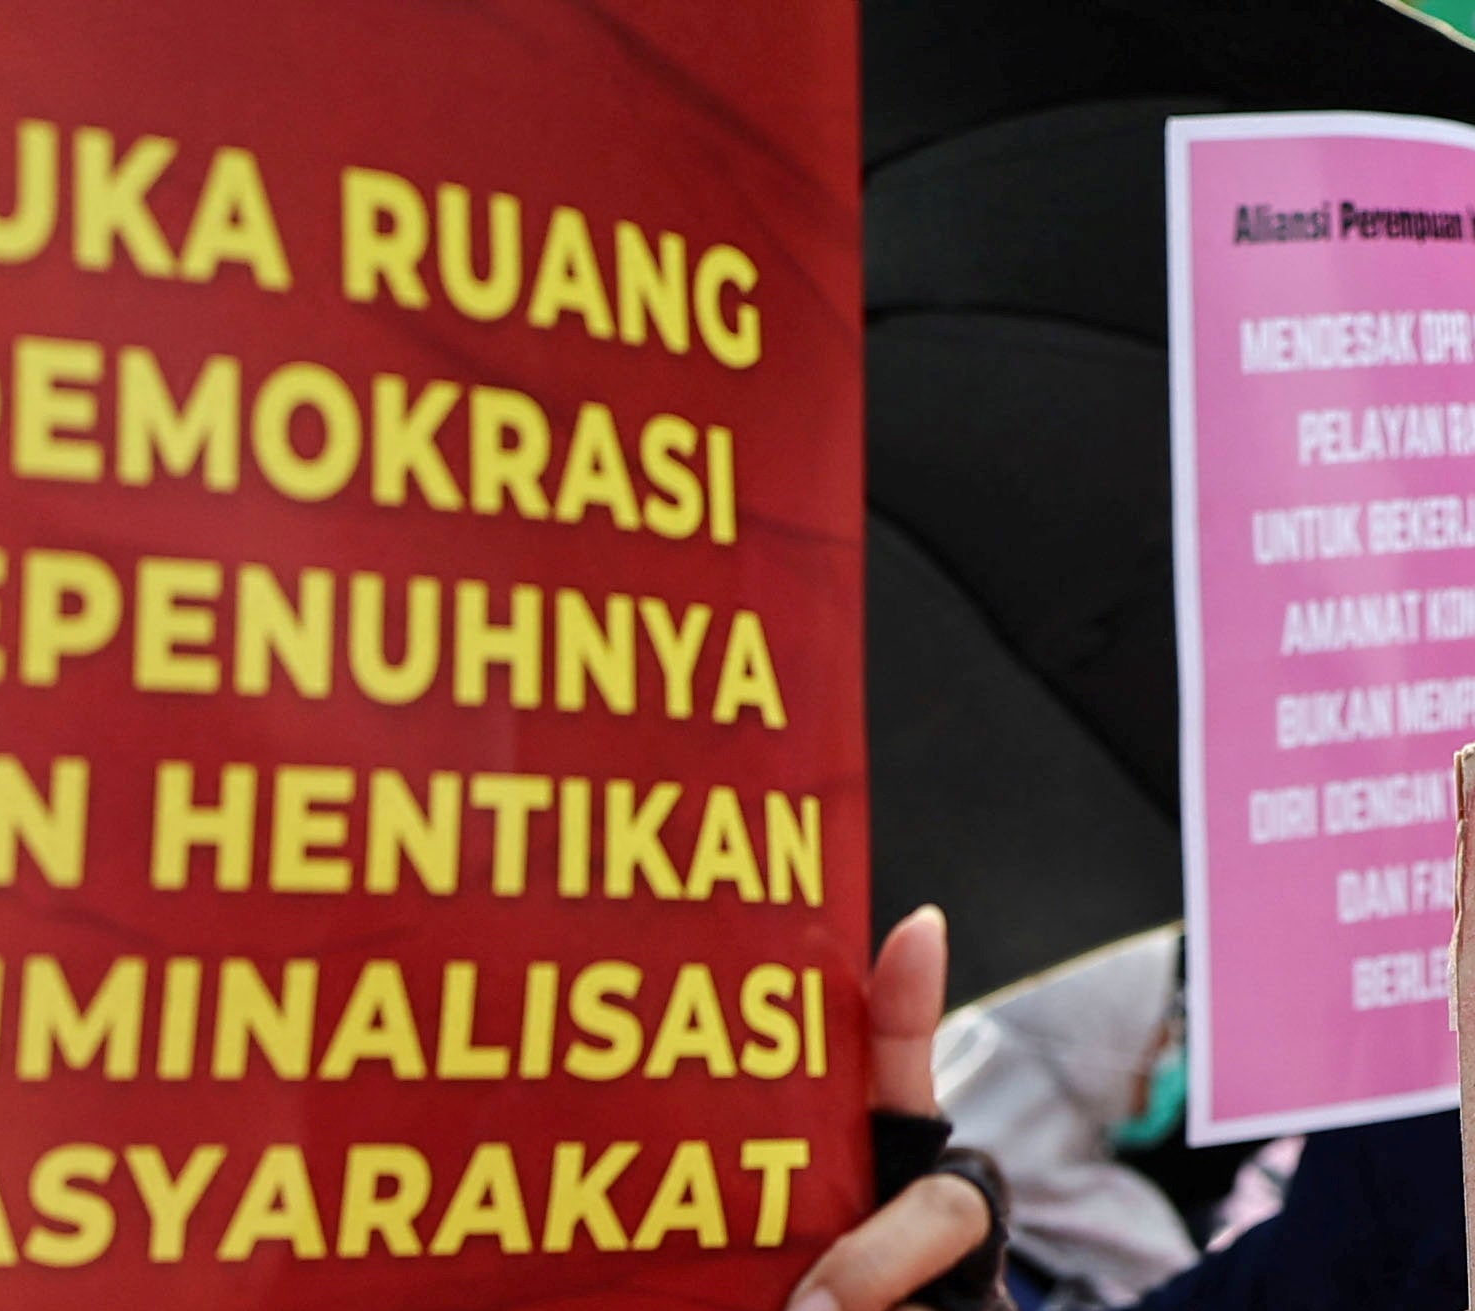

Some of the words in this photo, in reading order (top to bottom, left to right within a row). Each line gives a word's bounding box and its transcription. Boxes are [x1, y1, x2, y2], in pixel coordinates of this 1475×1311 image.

[1233, 202, 1332, 245] Aliansi
[1337, 201, 1464, 246] Perempuan
[342, 167, 761, 369] RUANG
[1239, 312, 1417, 376] MENDESAK
[1419, 309, 1472, 365] DPR
[1297, 403, 1446, 467] PELAYAN
[1252, 502, 1364, 565] UNTUK
[1279, 589, 1422, 657] AMANAT
[1275, 682, 1394, 750] BUKAN
[151, 761, 824, 907] HENTIKAN
[1249, 785, 1318, 846] DIRI
[1322, 770, 1447, 836] DENGAN
[1336, 863, 1409, 926] DAN
[1353, 944, 1450, 1011] BERLE
